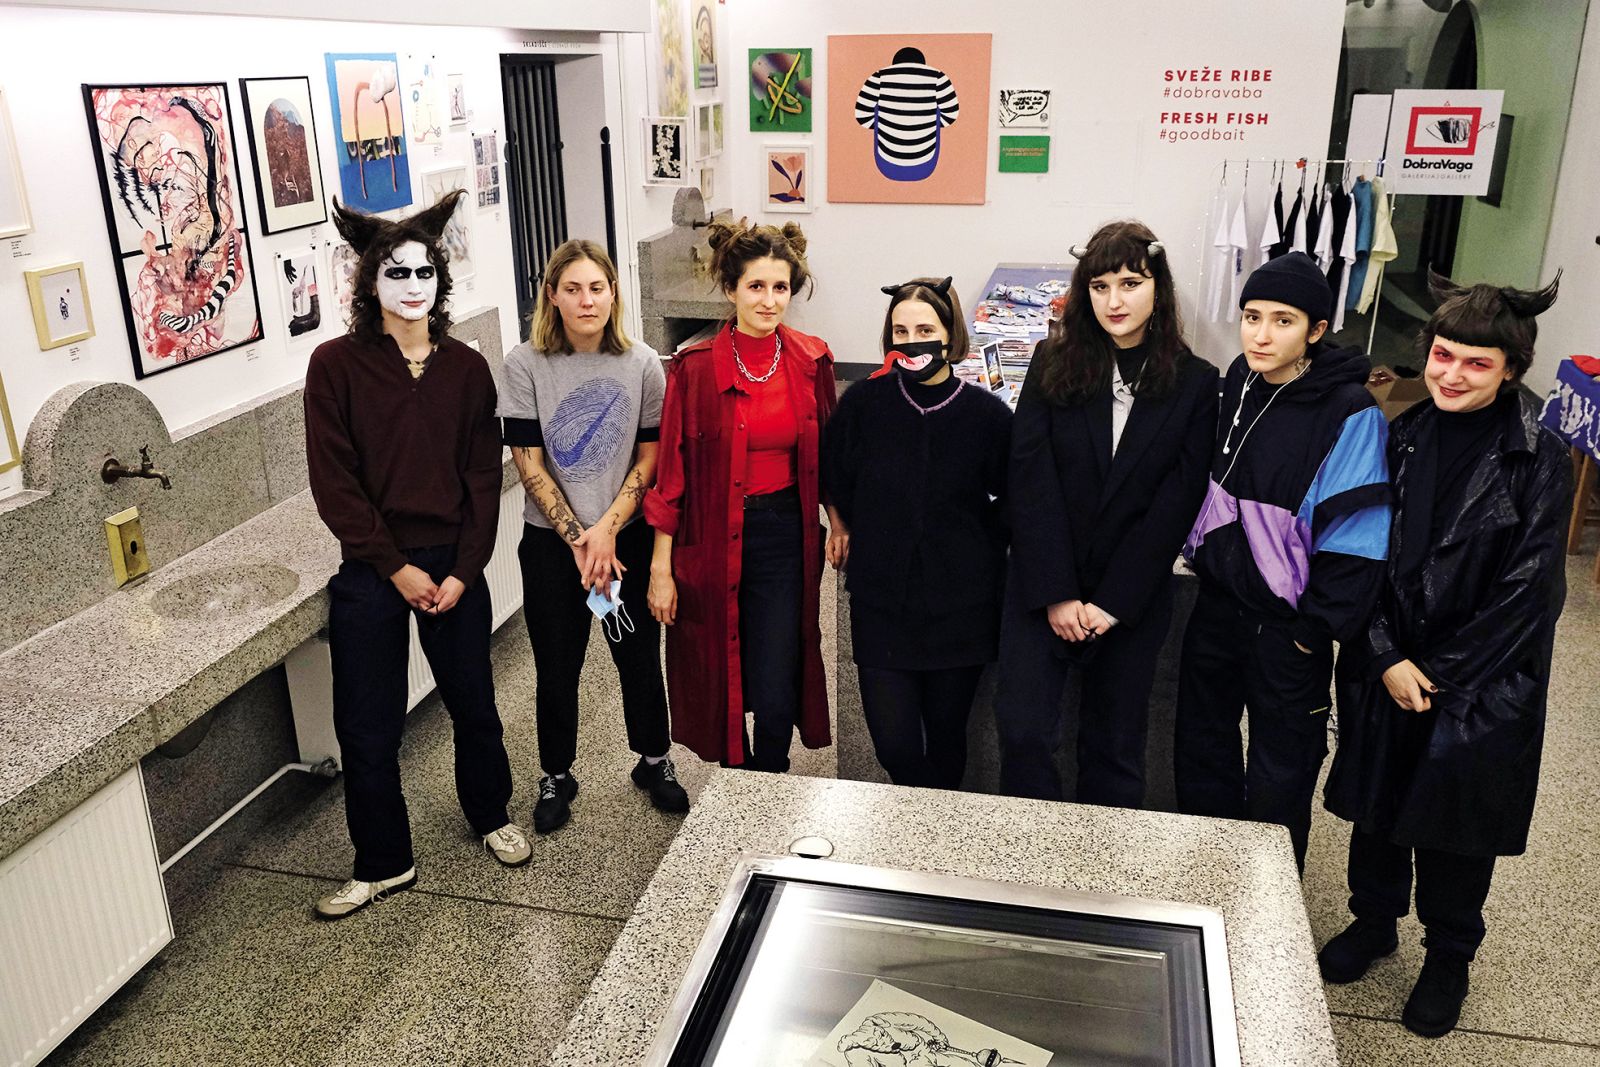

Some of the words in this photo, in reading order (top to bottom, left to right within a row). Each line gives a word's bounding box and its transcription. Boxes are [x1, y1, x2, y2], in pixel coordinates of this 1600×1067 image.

[1164, 66, 1222, 82] SVEŽE
[1231, 69, 1273, 82] RIBE
[1163, 86, 1263, 99] #dobravaba
[1160, 112, 1218, 124] FRESH
[1226, 112, 1269, 125] FISH
[1159, 128, 1246, 143] #goodbait
[1402, 158, 1473, 173] DobraVaga
